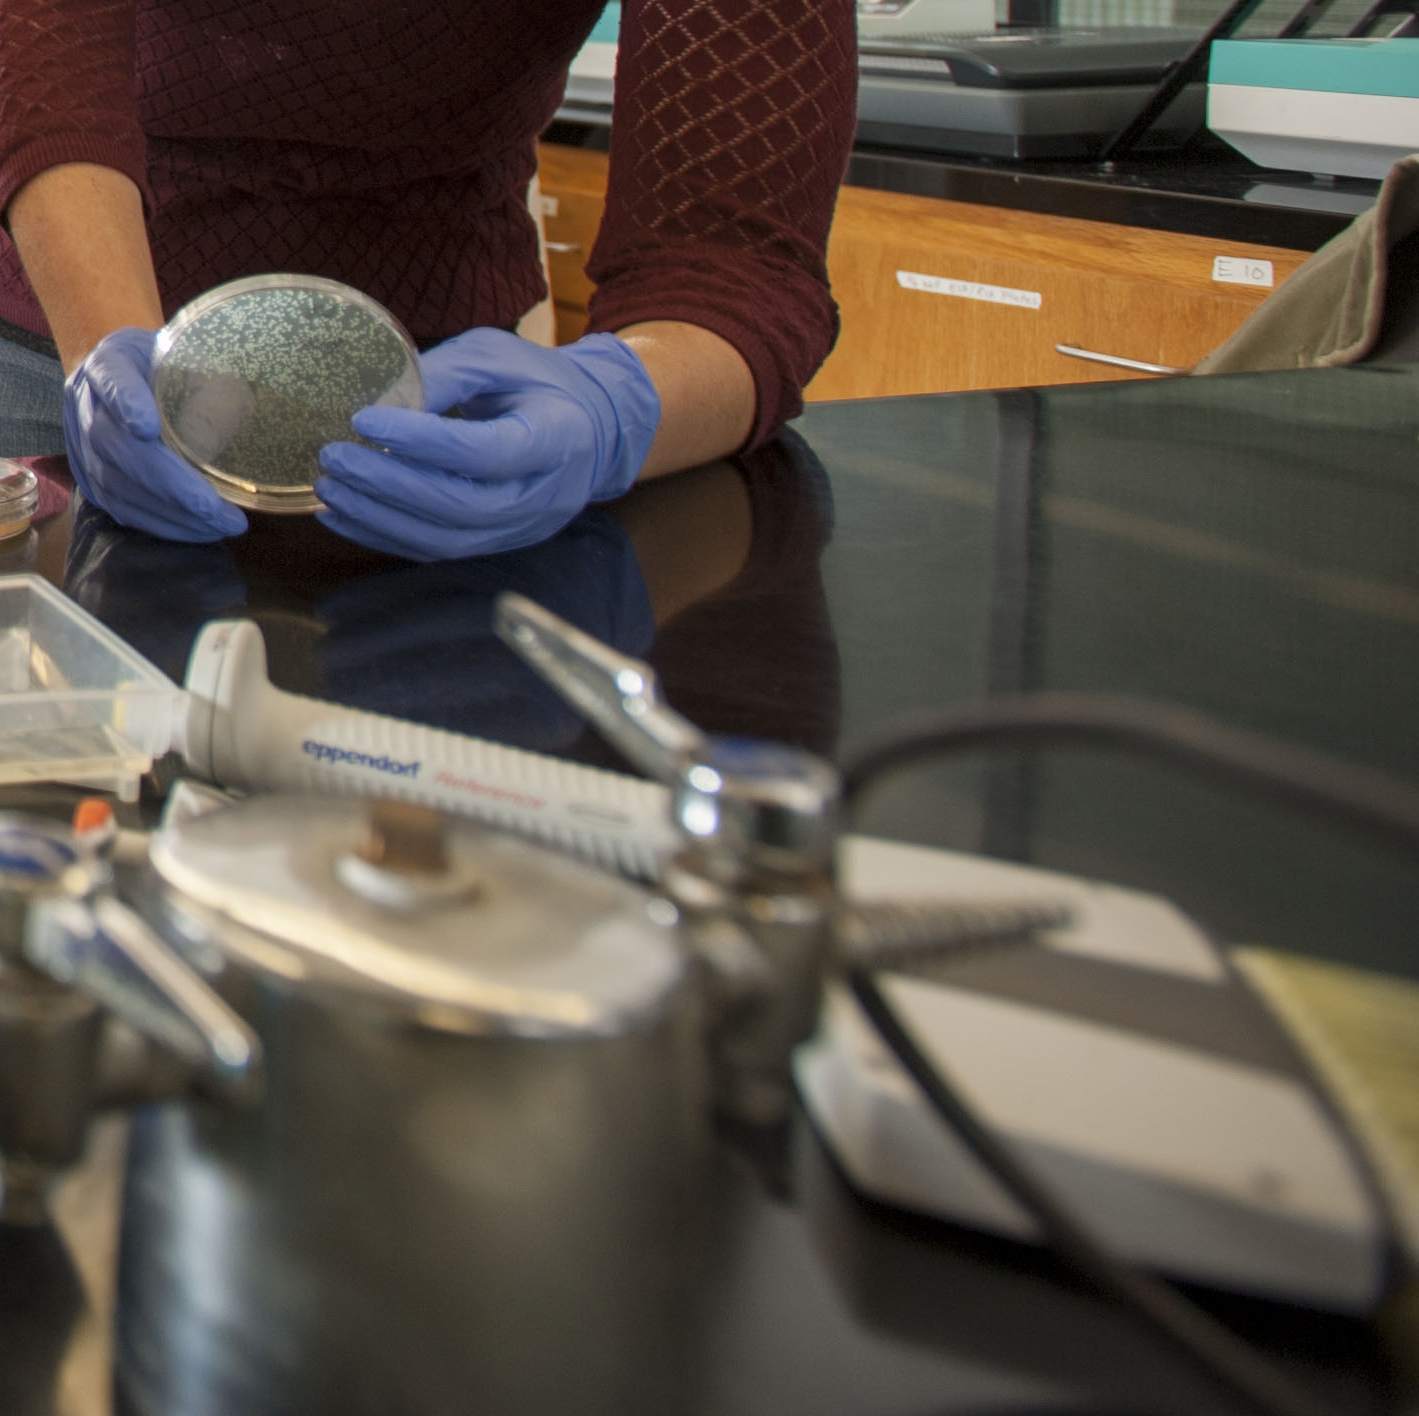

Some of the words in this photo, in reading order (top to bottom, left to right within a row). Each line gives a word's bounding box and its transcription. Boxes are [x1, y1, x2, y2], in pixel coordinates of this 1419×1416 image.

[1244, 264, 1266, 281] 10
[301, 738, 422, 779] eppendorf
[434, 769, 547, 810] Reference
